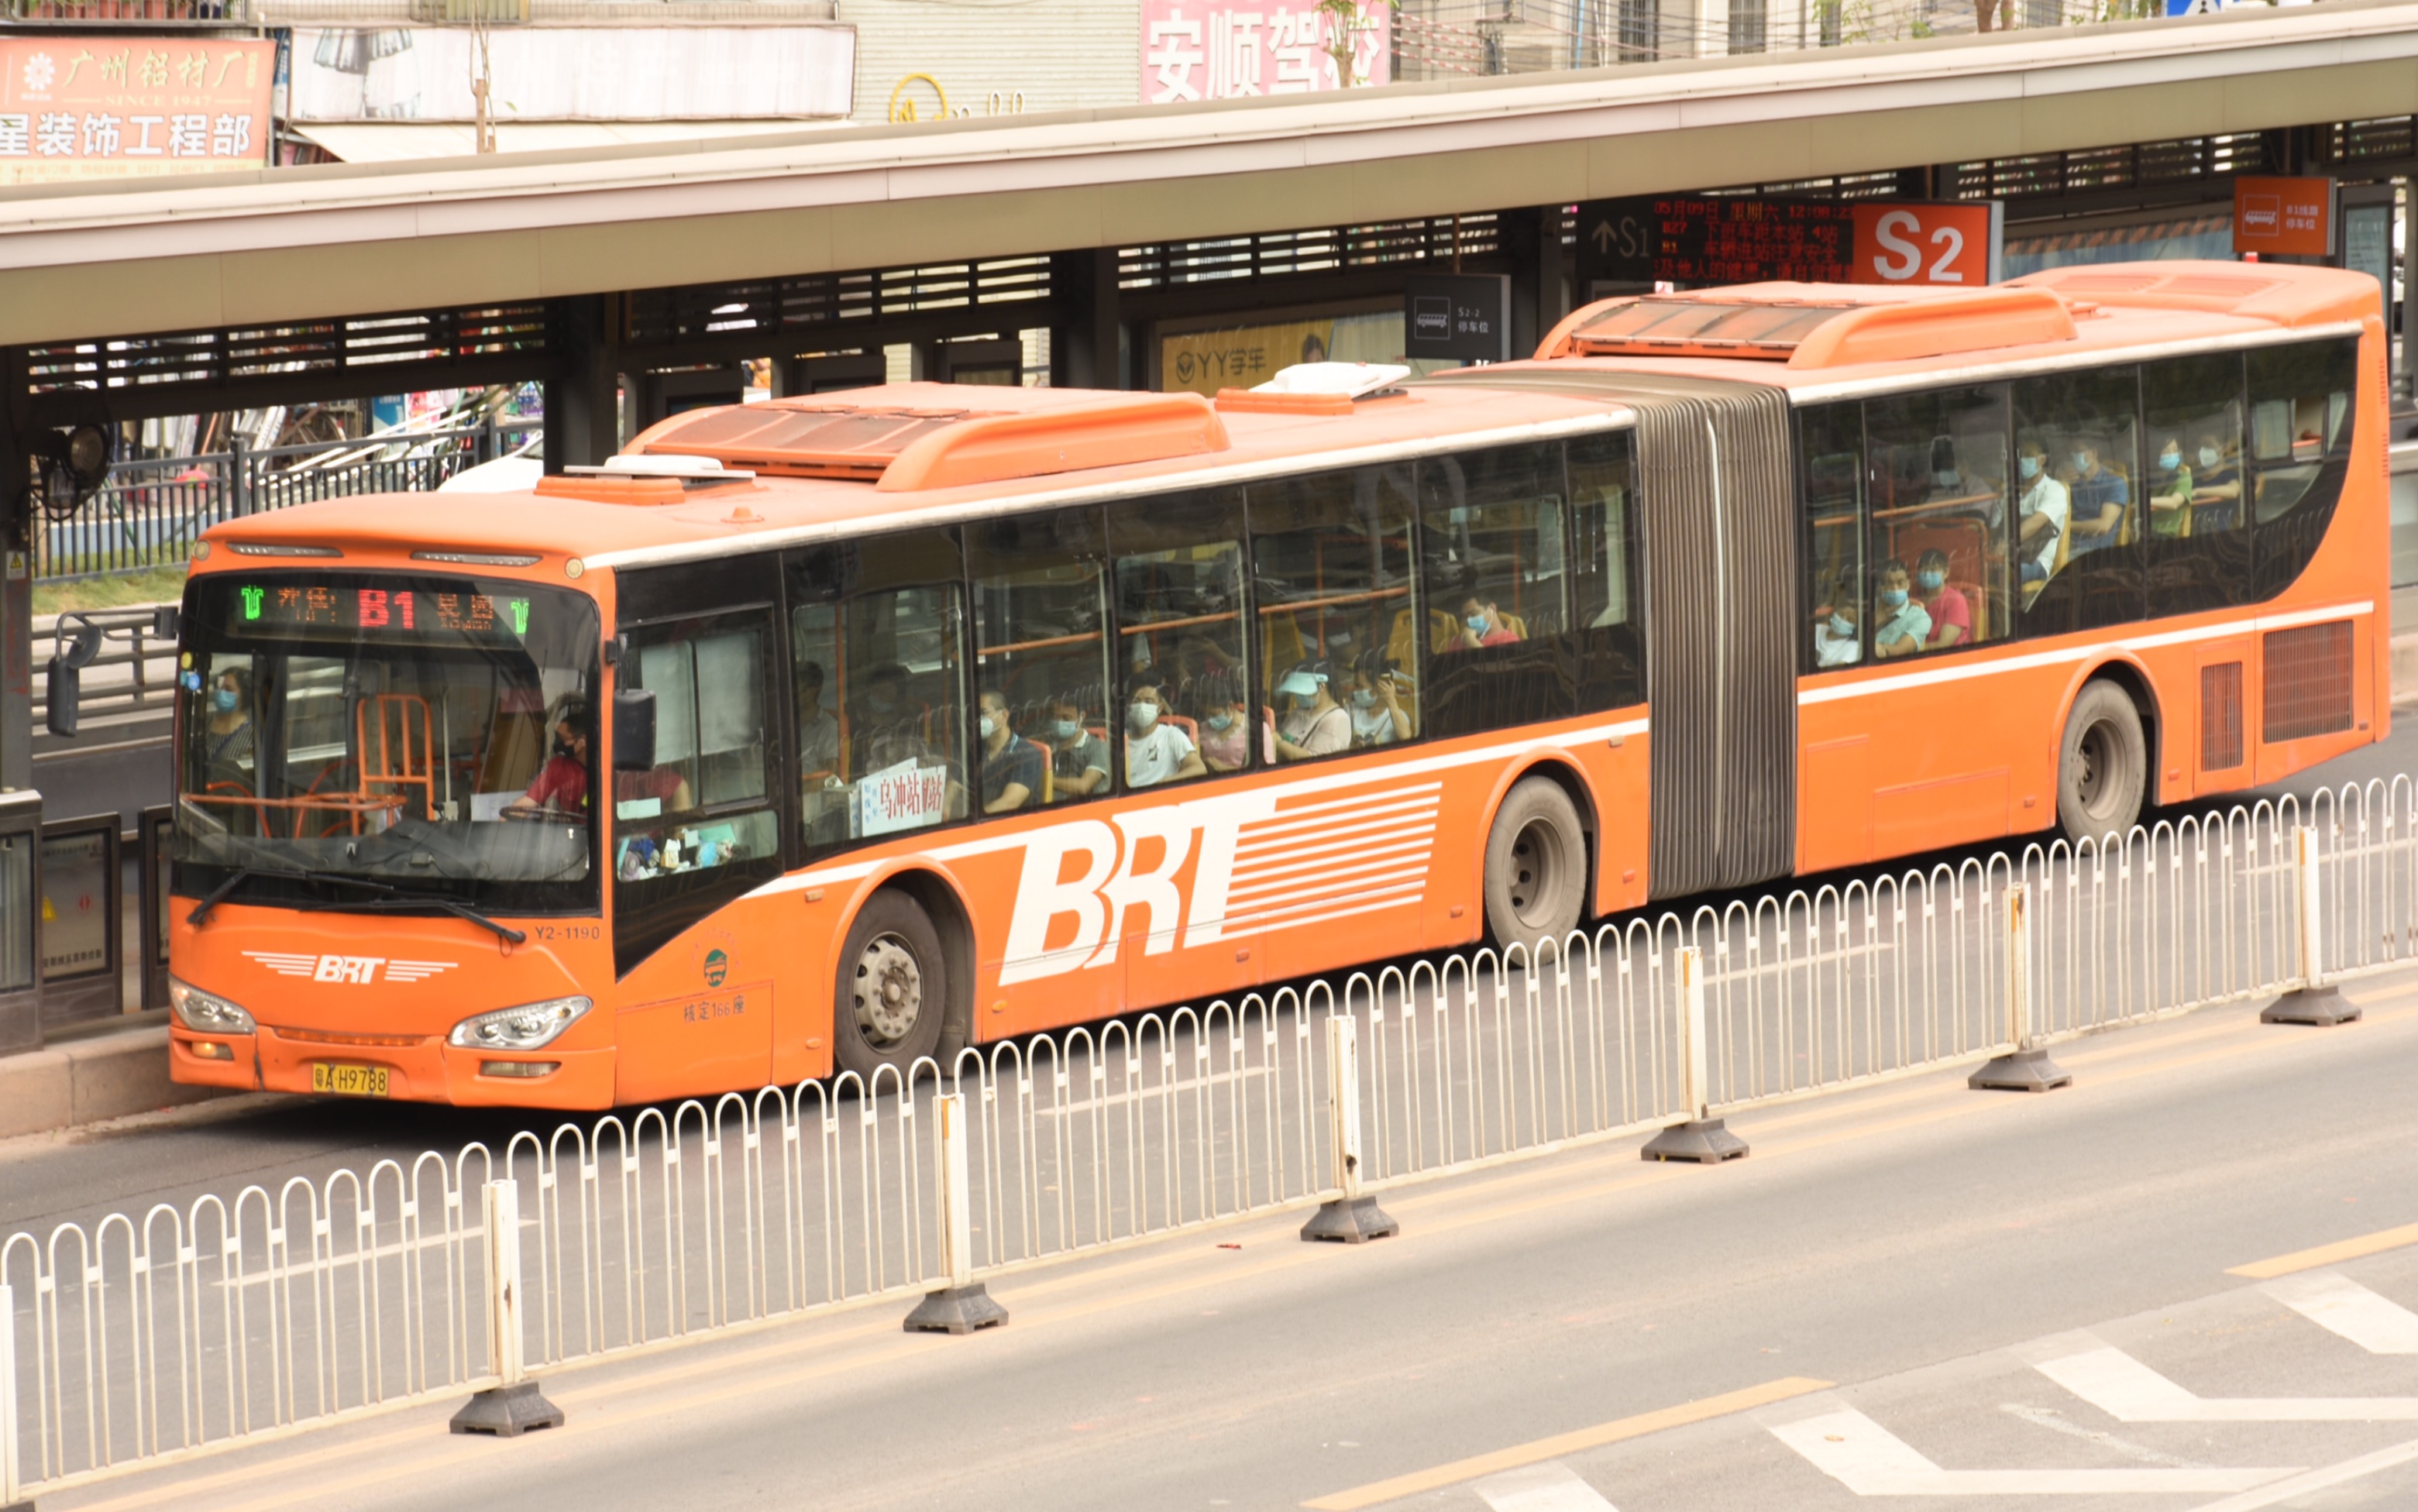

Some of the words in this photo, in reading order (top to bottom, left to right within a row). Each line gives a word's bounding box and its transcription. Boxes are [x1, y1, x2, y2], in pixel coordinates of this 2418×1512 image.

[105, 94, 166, 106] SINCE
[173, 95, 212, 107] 1947
[0, 112, 251, 158] 星装饰工程部
[1618, 216, 1651, 258] S1
[1872, 209, 1964, 282] S2
[1458, 321, 1490, 334] 停车位
[1195, 346, 1266, 378] YY学车
[358, 589, 414, 629] B1
[879, 772, 920, 820] 乌冲站
[998, 797, 1277, 987] BRT
[535, 926, 600, 940] Y2-1190
[314, 954, 386, 985] BRT
